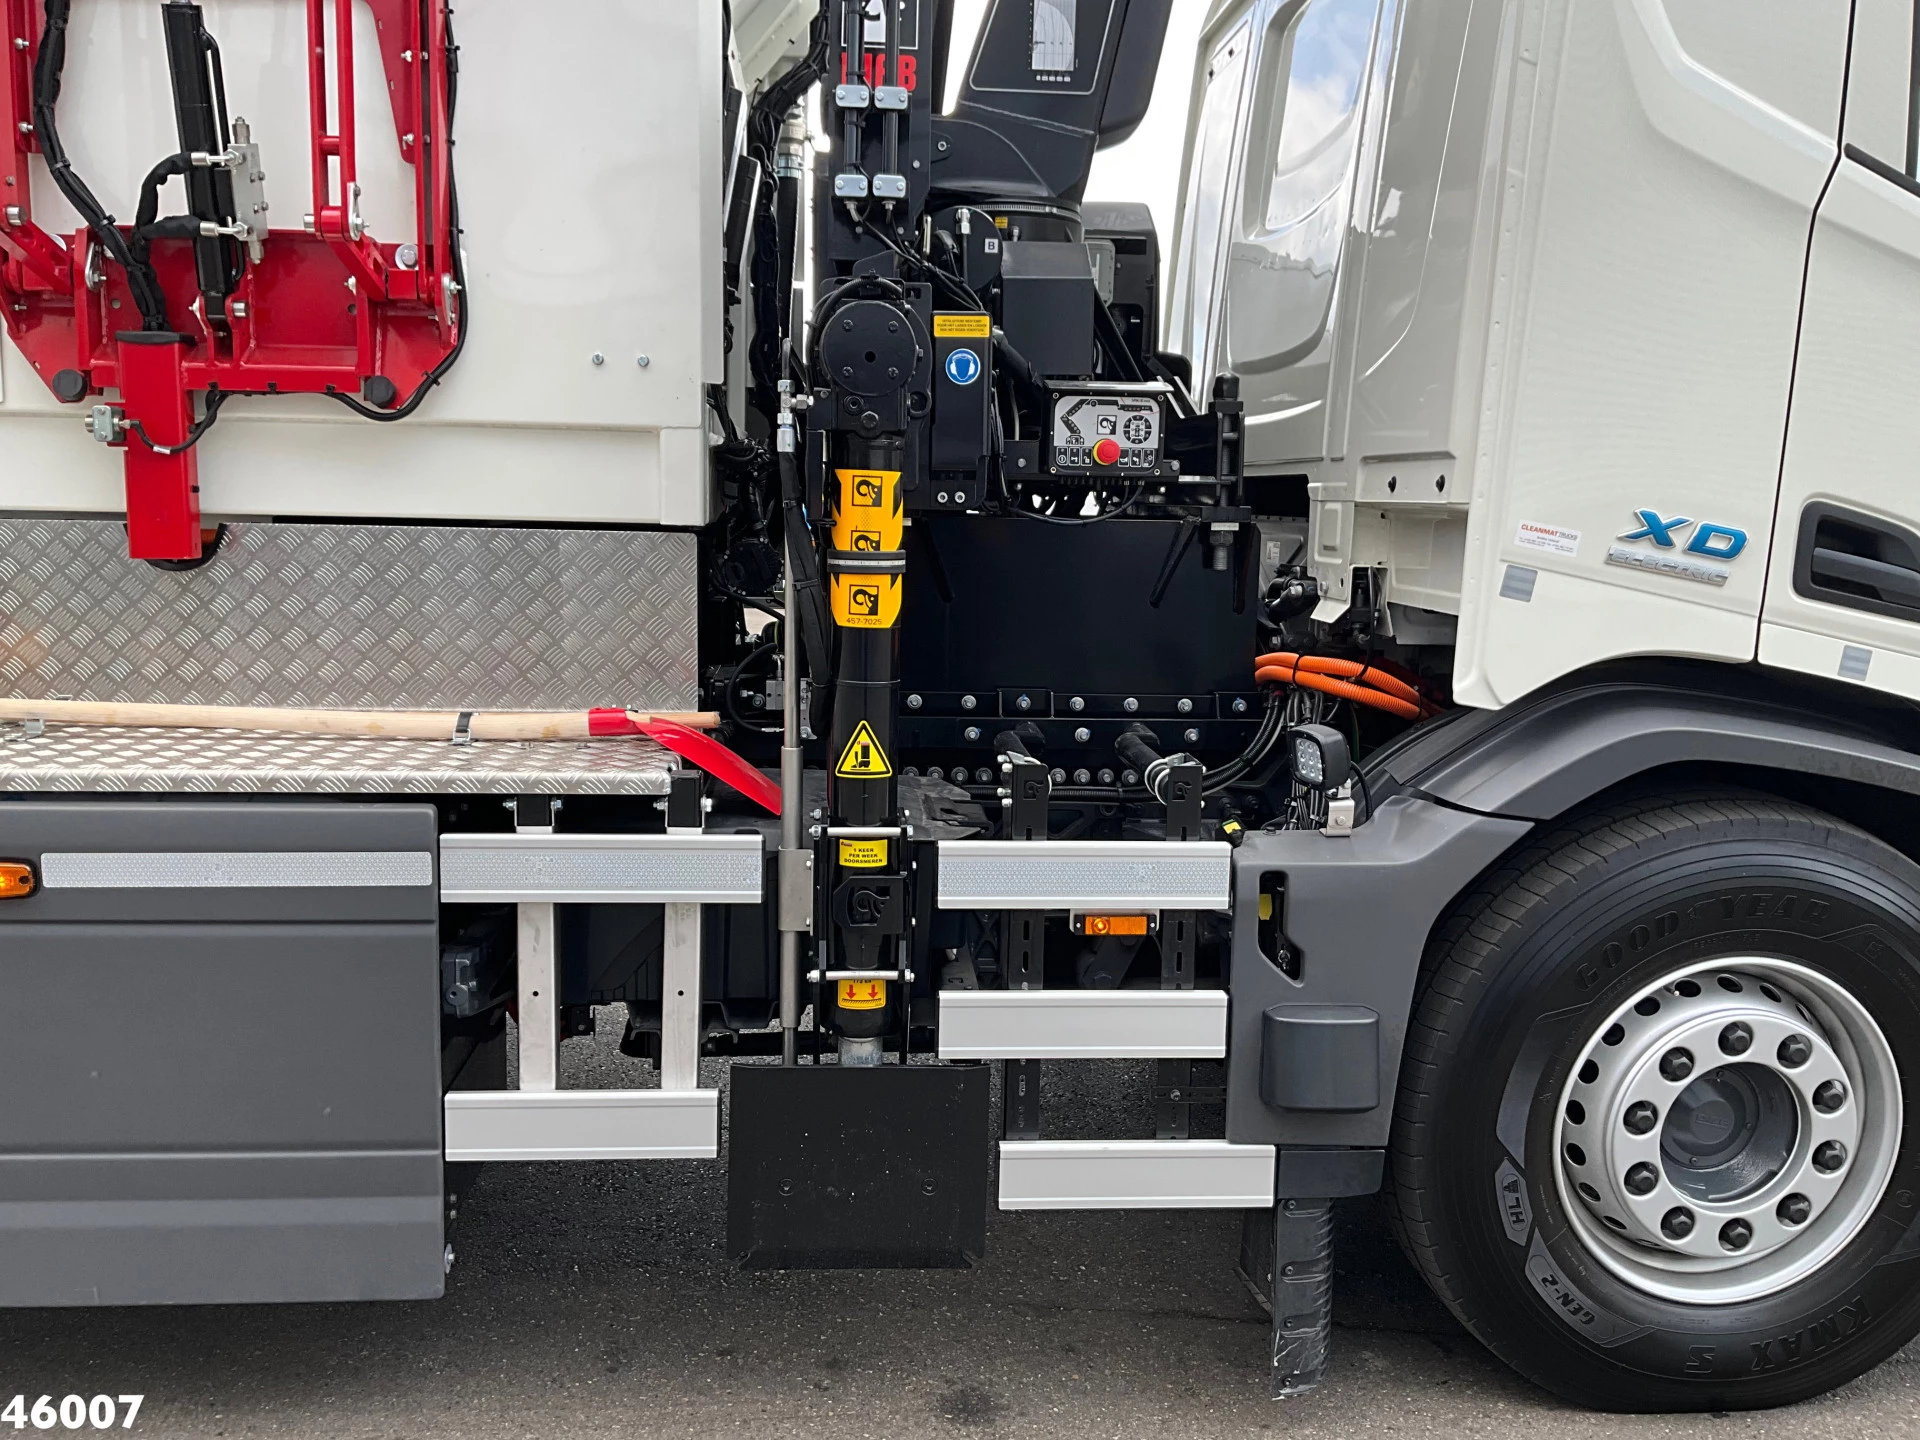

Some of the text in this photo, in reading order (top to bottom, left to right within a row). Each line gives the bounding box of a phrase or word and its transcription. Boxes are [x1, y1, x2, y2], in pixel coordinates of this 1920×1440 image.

[988, 241, 996, 251] B
[1521, 523, 1559, 537] CLEANMAT
[1616, 508, 1749, 562] XD
[1611, 549, 1728, 582] ELECTRIC
[846, 617, 882, 625] 457-7025
[1541, 1273, 1597, 1326] GEN-2
[1750, 1296, 1872, 1371] KMAX
